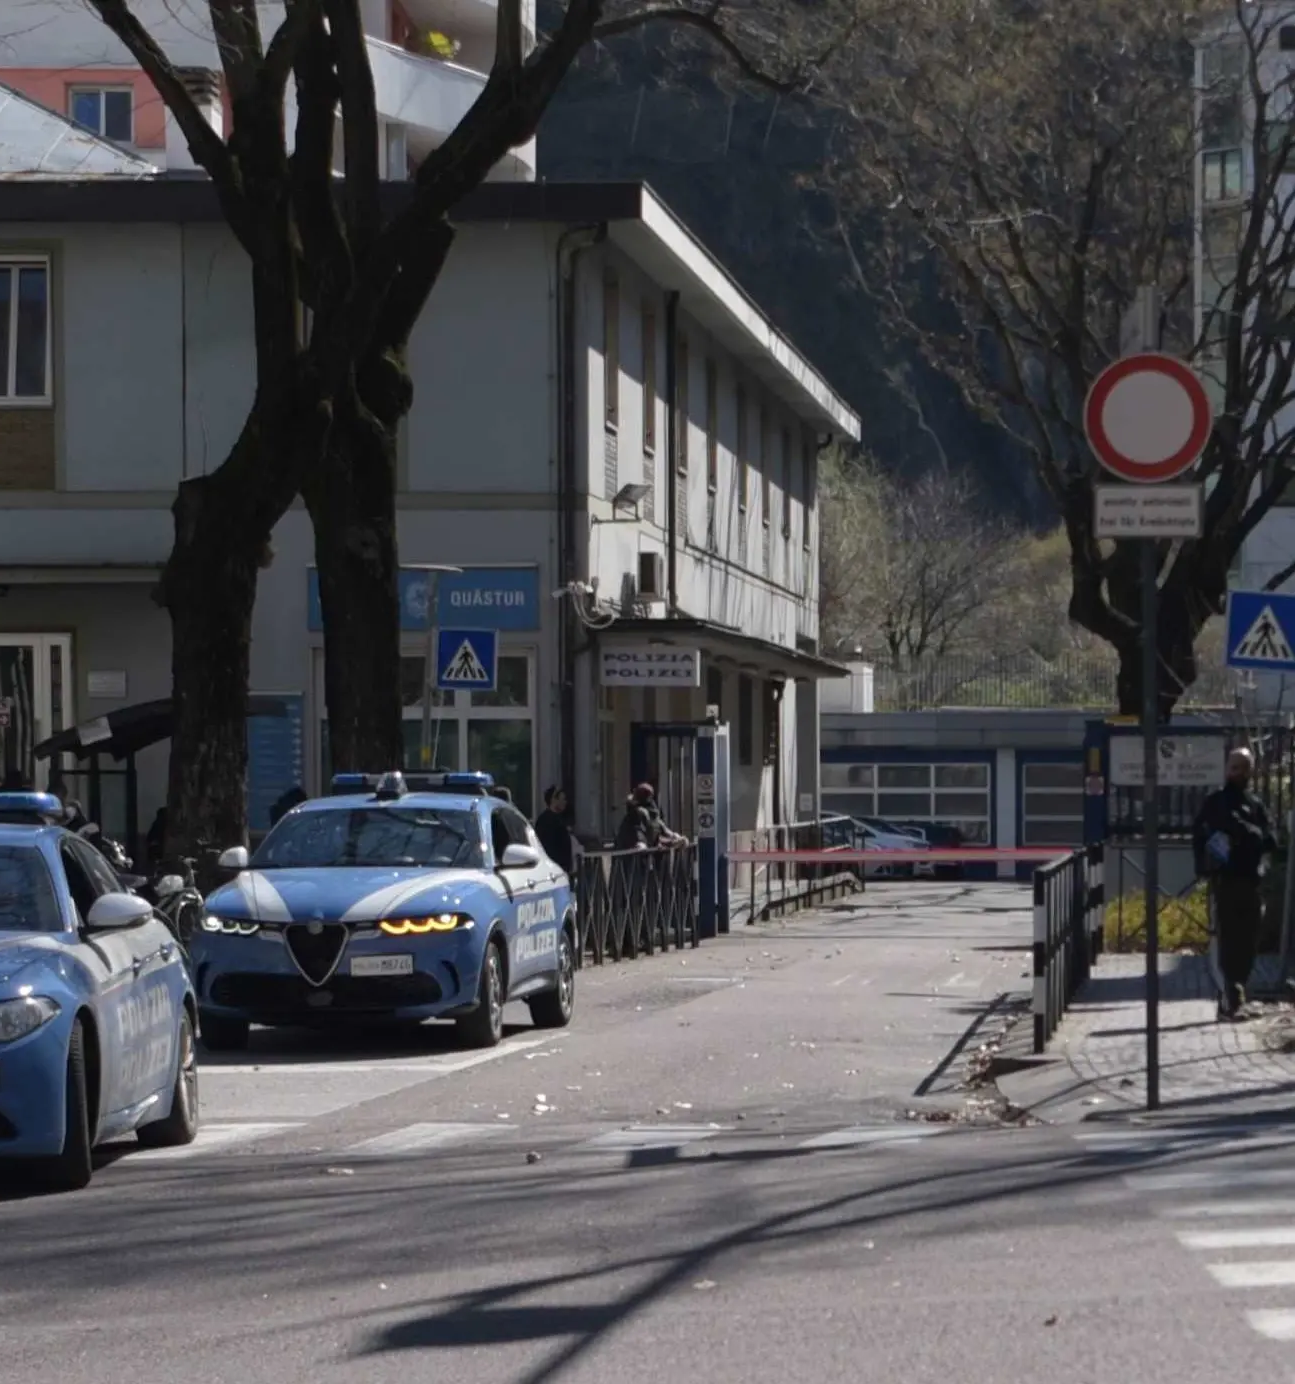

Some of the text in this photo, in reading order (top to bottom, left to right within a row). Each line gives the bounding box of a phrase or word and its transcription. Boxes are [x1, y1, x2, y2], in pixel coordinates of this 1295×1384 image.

[450, 587, 525, 607] QUÄSTUR
[603, 652, 694, 662] POLIZIA
[604, 667, 692, 678] POLIZEI
